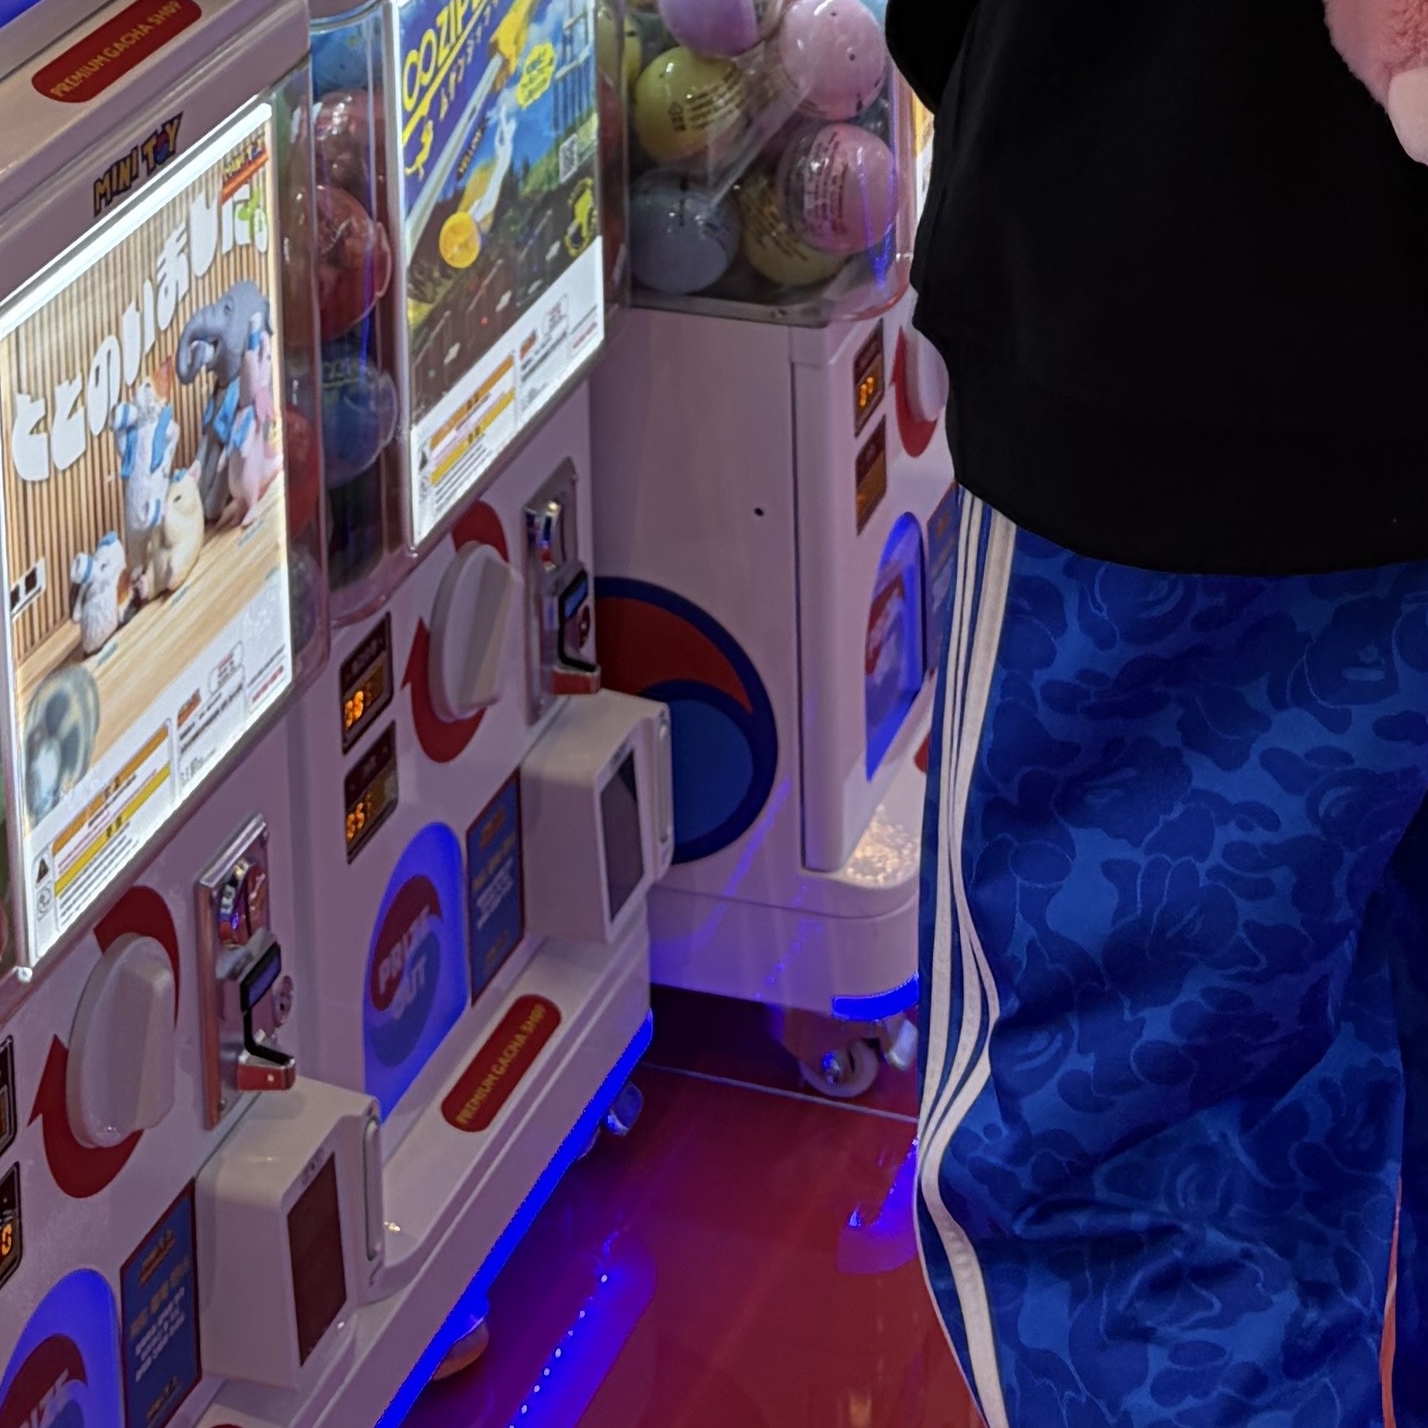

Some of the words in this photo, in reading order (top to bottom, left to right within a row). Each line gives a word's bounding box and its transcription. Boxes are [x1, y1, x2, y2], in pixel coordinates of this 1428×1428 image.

[50, 48, 110, 101] PREMIUM
[104, 22, 152, 61] GACHA
[93, 152, 140, 218] MINI
